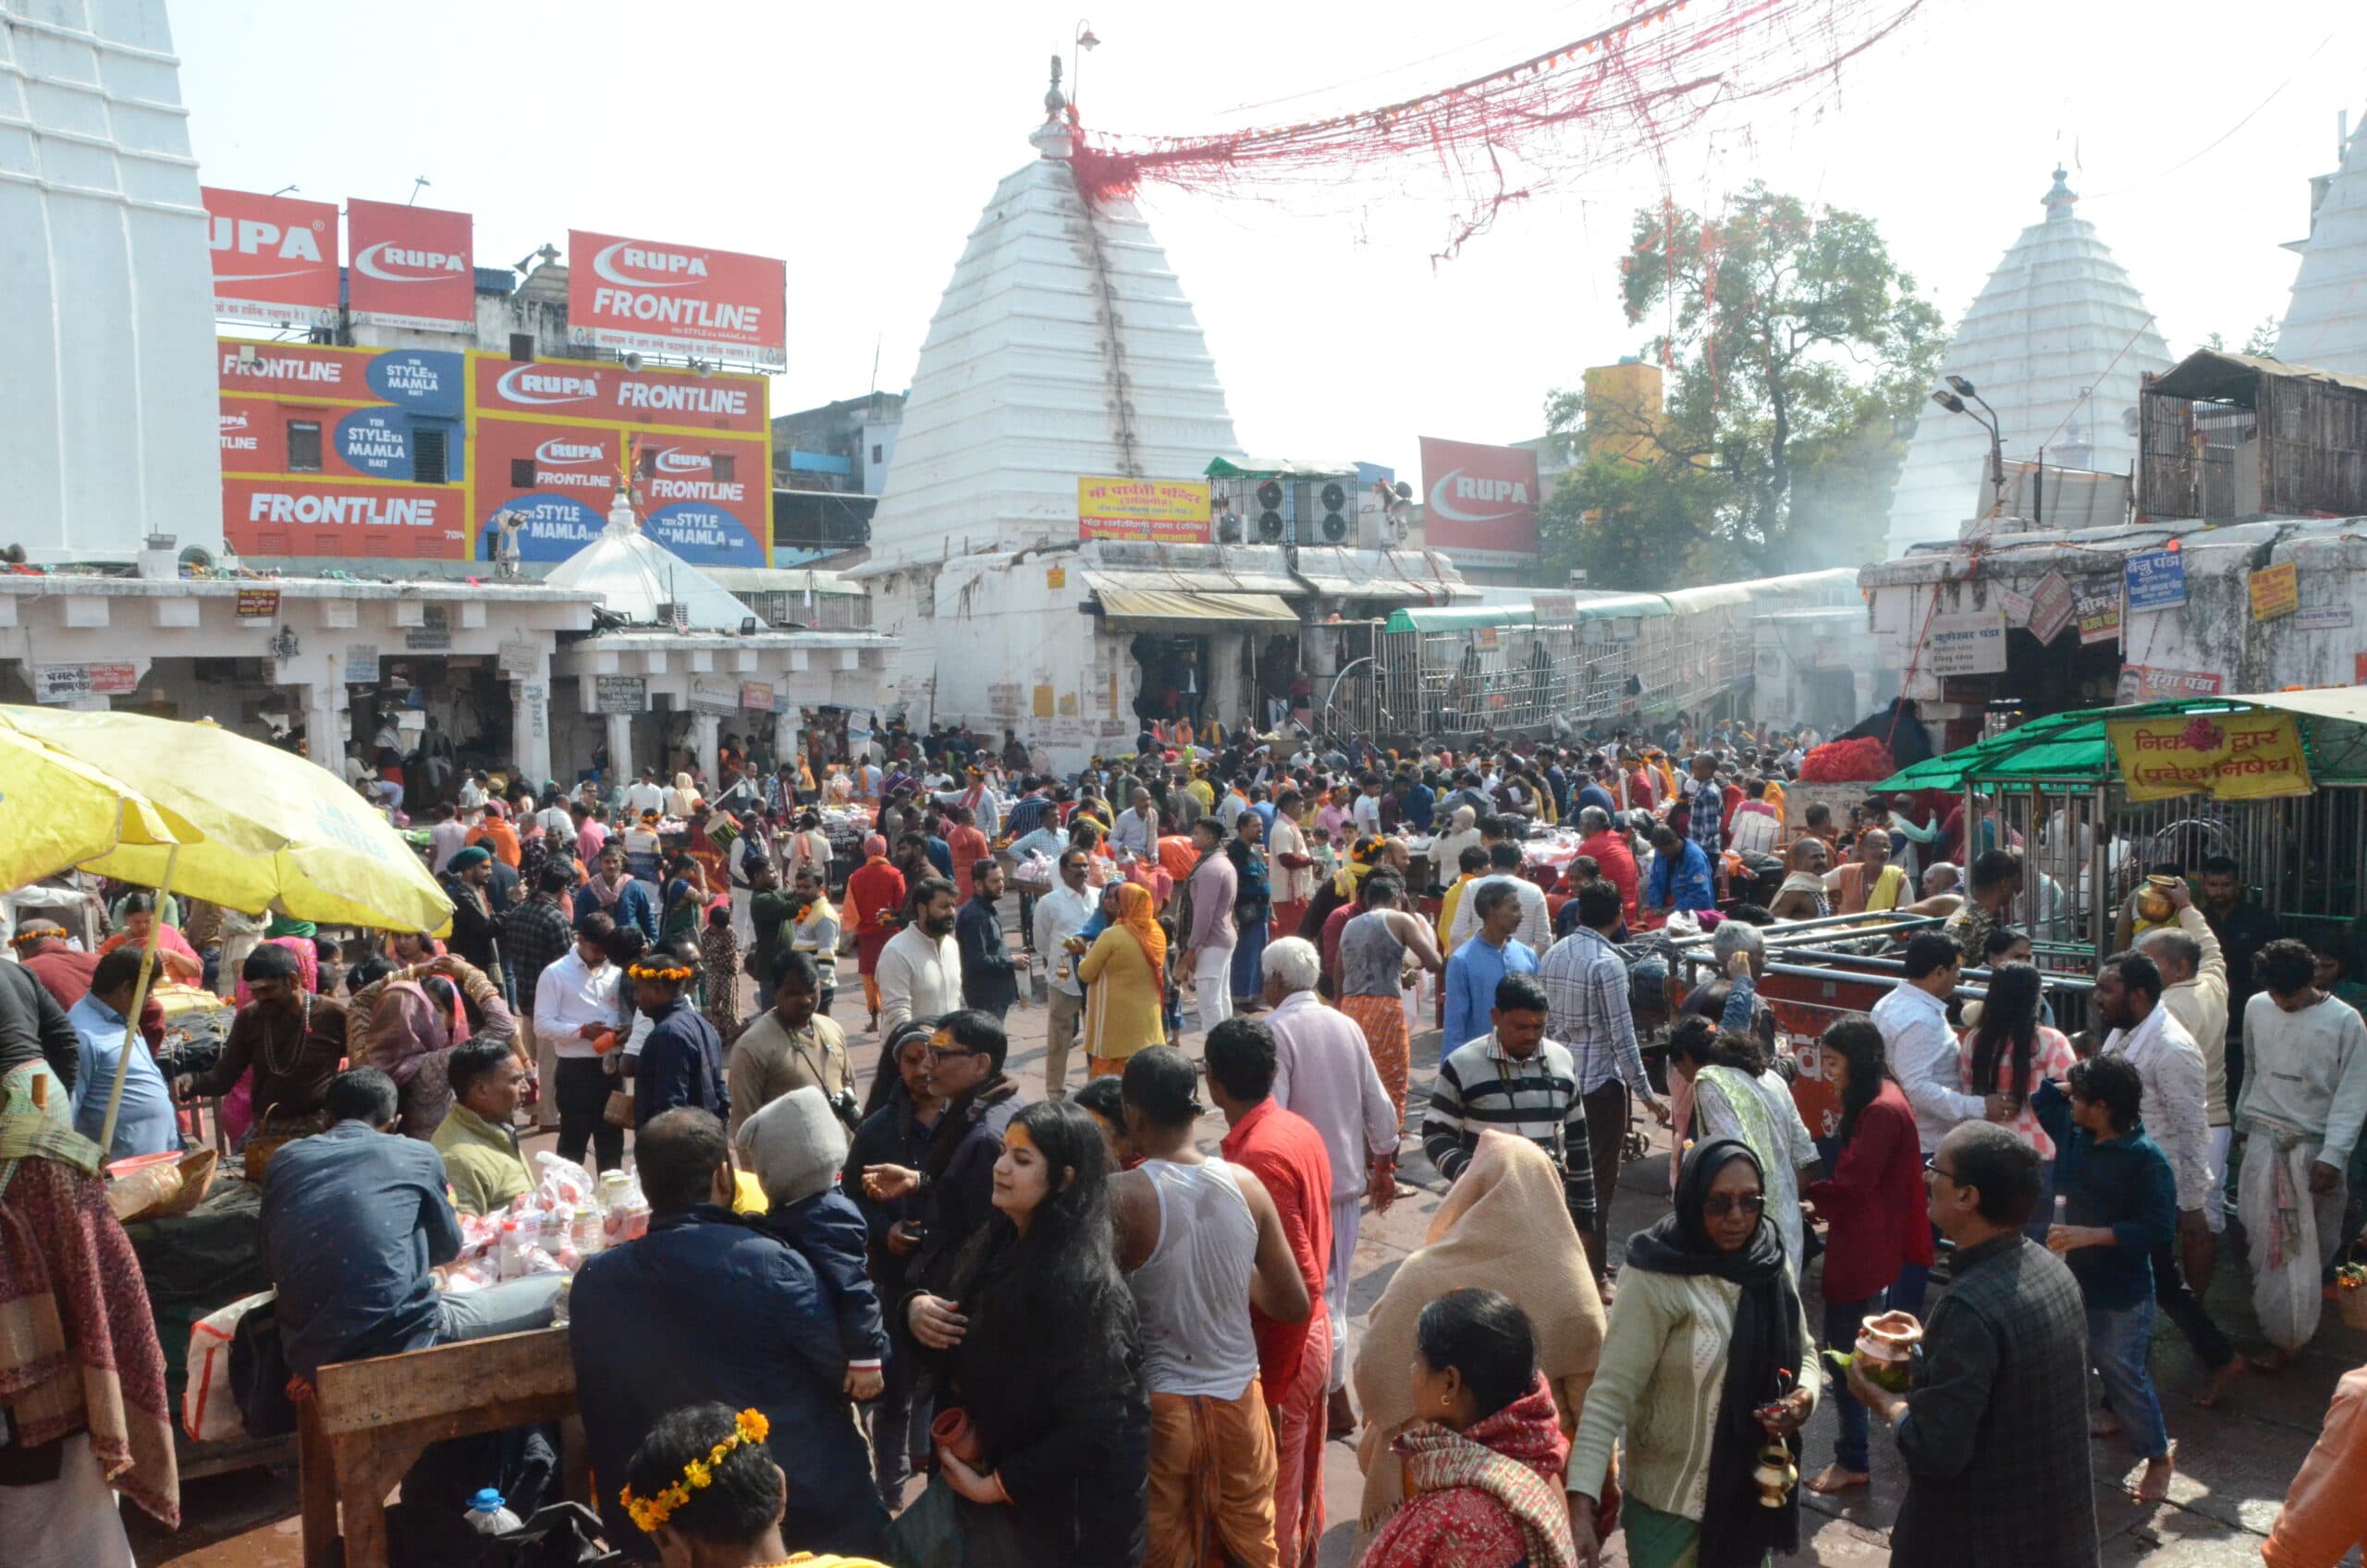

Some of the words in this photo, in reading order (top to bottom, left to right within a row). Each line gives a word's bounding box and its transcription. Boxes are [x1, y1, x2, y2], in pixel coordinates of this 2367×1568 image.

[209, 216, 323, 263] UPA
[384, 246, 465, 272] RUPA
[623, 247, 708, 277] RUPA
[593, 288, 761, 333] FRONTLINE
[223, 354, 342, 382] FRONTLINE
[386, 364, 428, 378] STYLE
[388, 376, 439, 391] MAMLA
[521, 374, 598, 396] RUPA
[617, 381, 748, 415] FRONTLINE
[348, 426, 391, 442] STYLE
[348, 442, 406, 459] MAMLA
[551, 441, 604, 459] RUPA
[668, 453, 713, 467] RUPA
[535, 472, 612, 488] FRONTLINE
[650, 477, 745, 502] FRONTLINE
[1456, 476, 1529, 505] RUPA
[249, 492, 438, 526] FRONTLINE
[535, 504, 581, 522] STYLE
[676, 512, 718, 529] STYLE
[531, 521, 588, 541] MAMLA
[657, 527, 672, 537] KA
[671, 528, 727, 547] MAMLA
[2152, 552, 2180, 569] पंडा
[2230, 727, 2280, 753] द्वार
